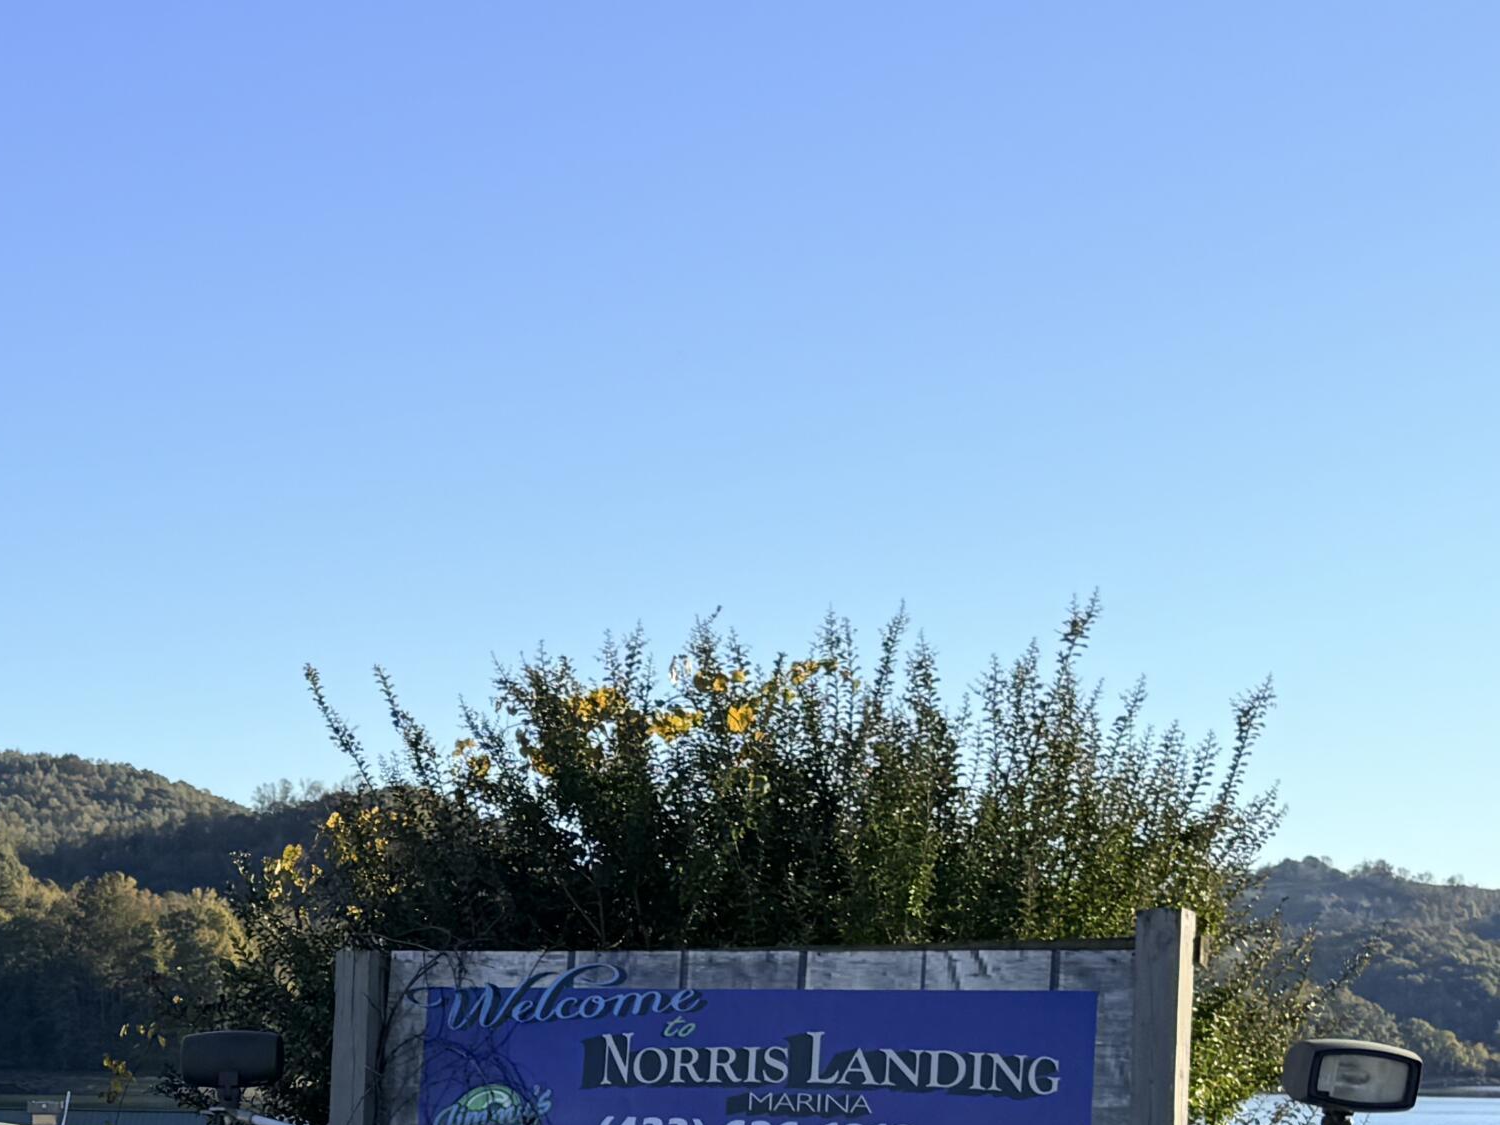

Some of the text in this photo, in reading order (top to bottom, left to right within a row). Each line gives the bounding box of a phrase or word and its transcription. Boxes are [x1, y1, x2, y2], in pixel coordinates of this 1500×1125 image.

[407, 963, 707, 1032] Welcome
[663, 1015, 697, 1038] to
[599, 1031, 1061, 1097] NORRIS LANDING
[747, 1092, 873, 1115] MARINA
